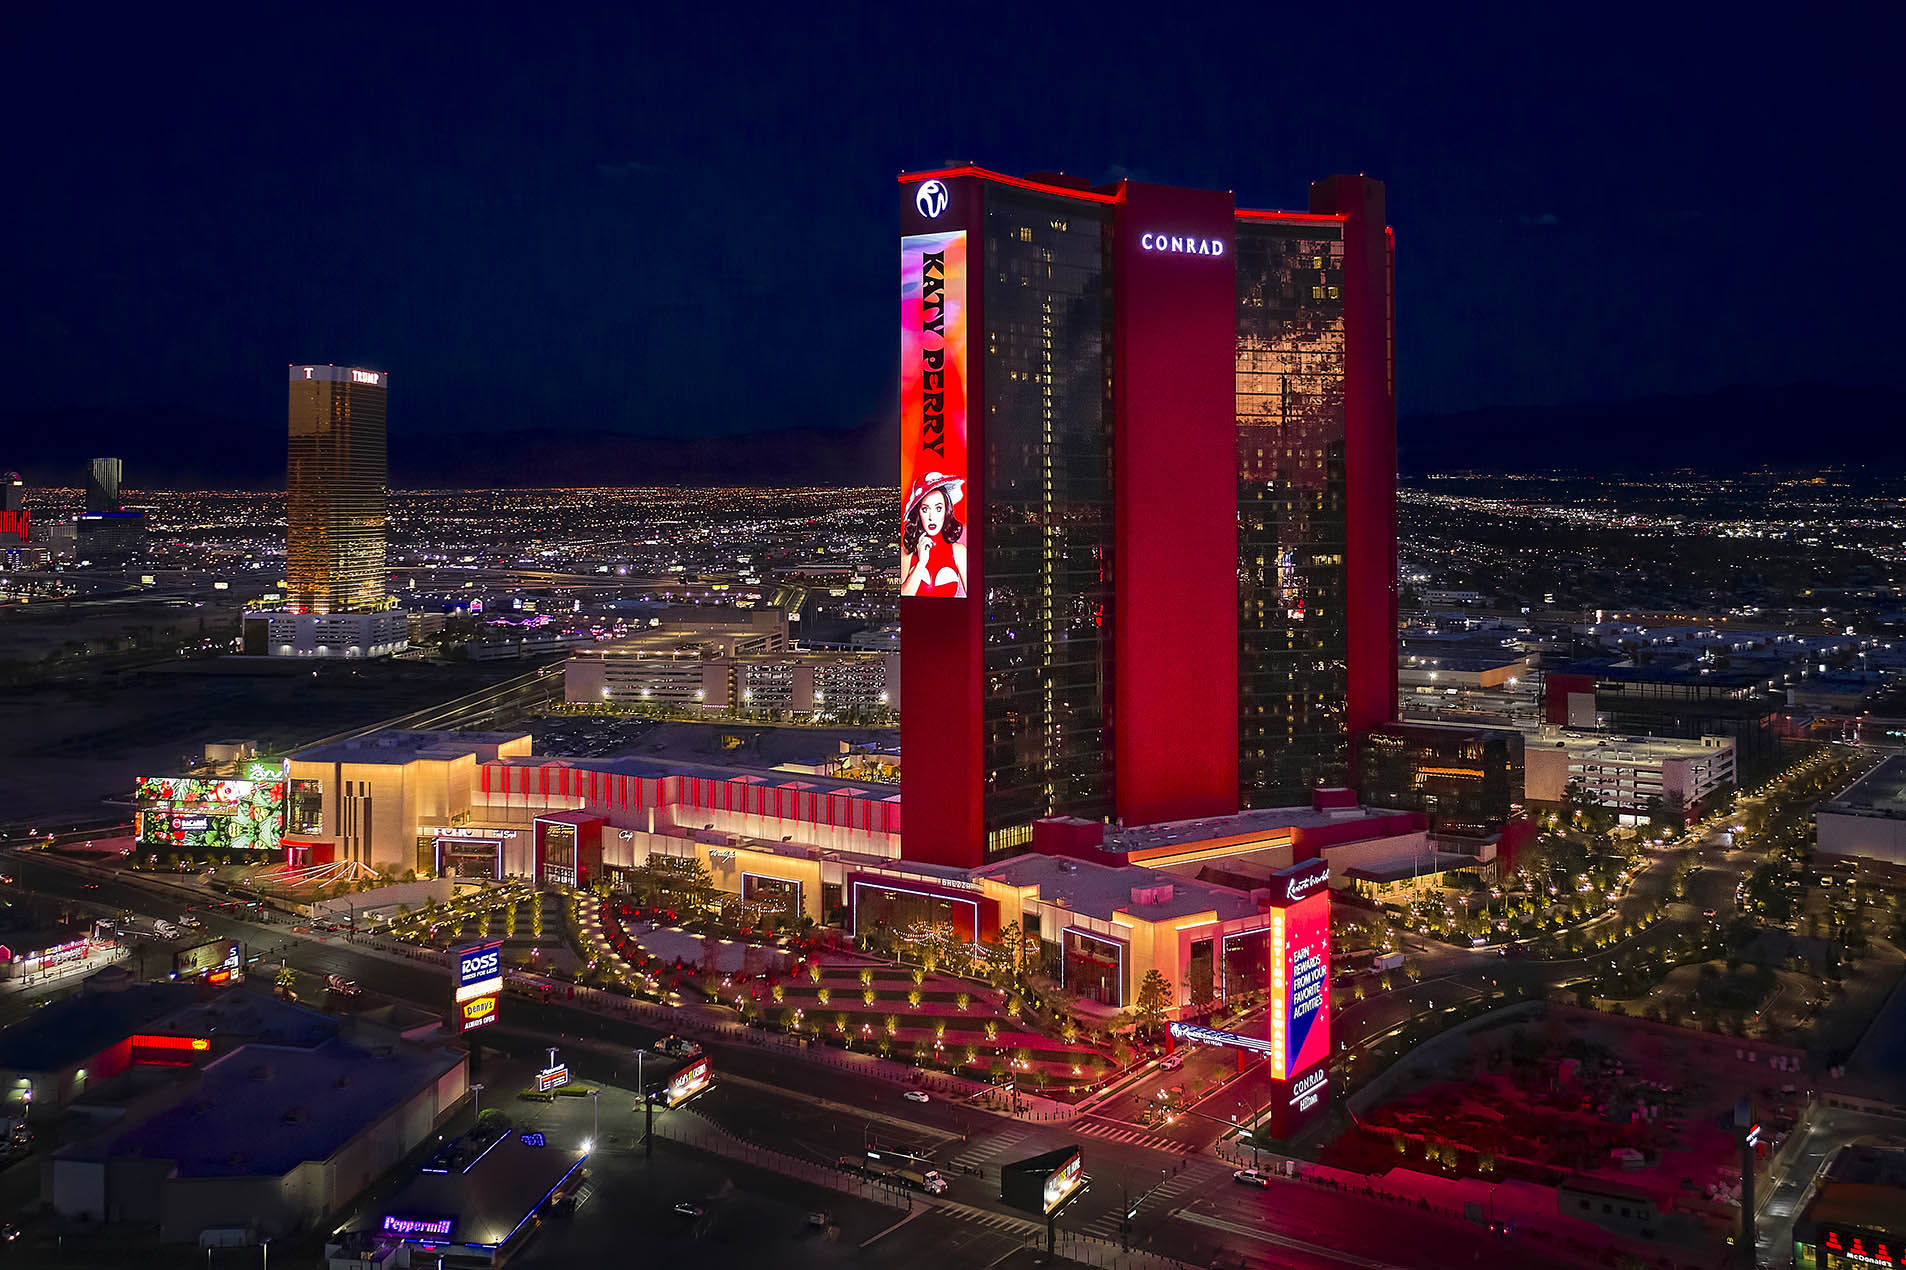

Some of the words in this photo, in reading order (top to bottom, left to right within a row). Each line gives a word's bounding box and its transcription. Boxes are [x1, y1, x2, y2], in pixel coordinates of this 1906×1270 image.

[1142, 233, 1224, 256] CONRAD
[922, 251, 945, 338] KATY
[352, 370, 379, 385] TRUMP
[922, 347, 945, 459] PERRY
[941, 878, 971, 890] BREZZA
[462, 952, 498, 974] ROSS
[1293, 945, 1310, 963] EARN
[1293, 954, 1321, 977] REWARDS
[1293, 972, 1311, 991] FROM
[1311, 964, 1327, 982] YOUR
[1293, 981, 1321, 1005] FAVORITE
[467, 1000, 493, 1016] Denny's
[1293, 993, 1323, 1020] ACTIVITIES
[1293, 1068, 1324, 1096] CONRAD
[1300, 1093, 1318, 1112] Hilton
[384, 1215, 452, 1234] Peppermill
[1846, 1251, 1893, 1267] McDonald's
